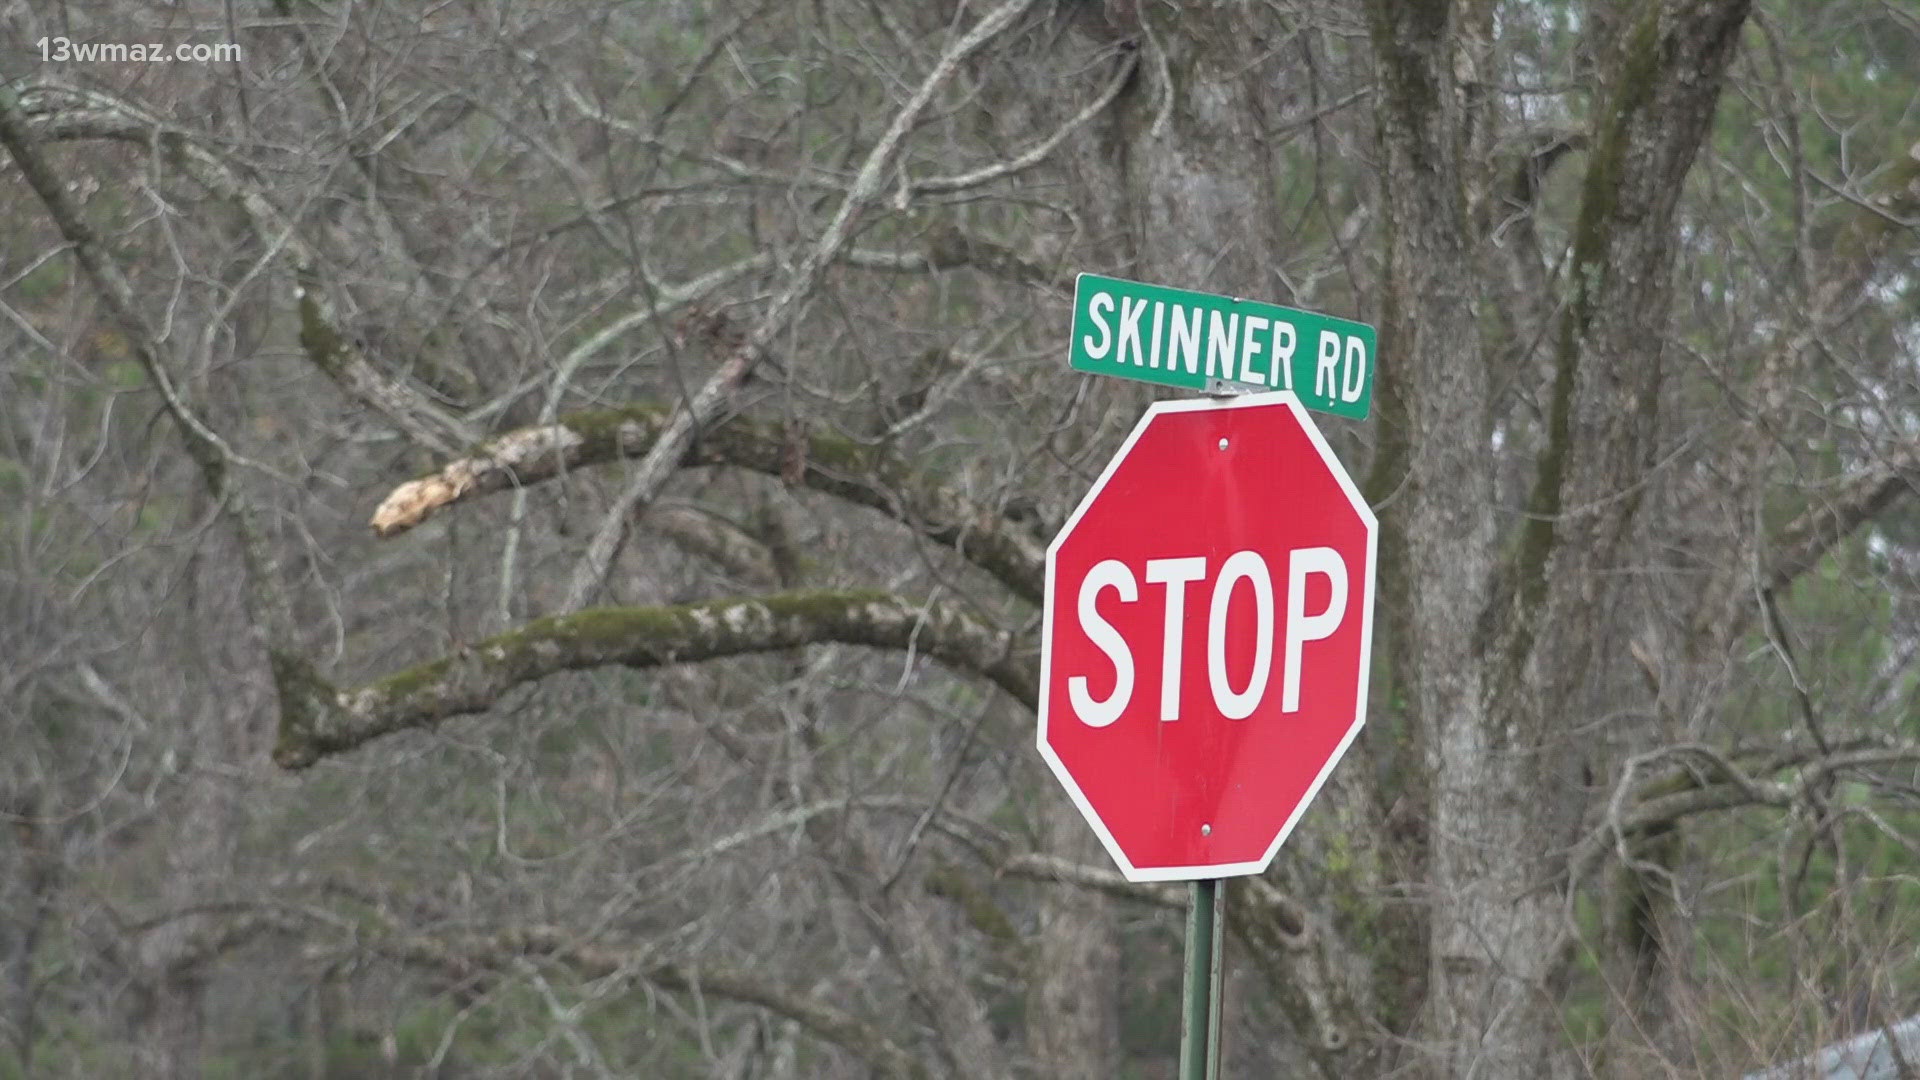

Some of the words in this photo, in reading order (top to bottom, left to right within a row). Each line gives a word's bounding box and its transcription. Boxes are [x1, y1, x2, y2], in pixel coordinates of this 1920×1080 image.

[1083, 292, 1297, 389] SKINNER
[1315, 330, 1367, 403] RD
[1068, 547, 1349, 727] STOP
